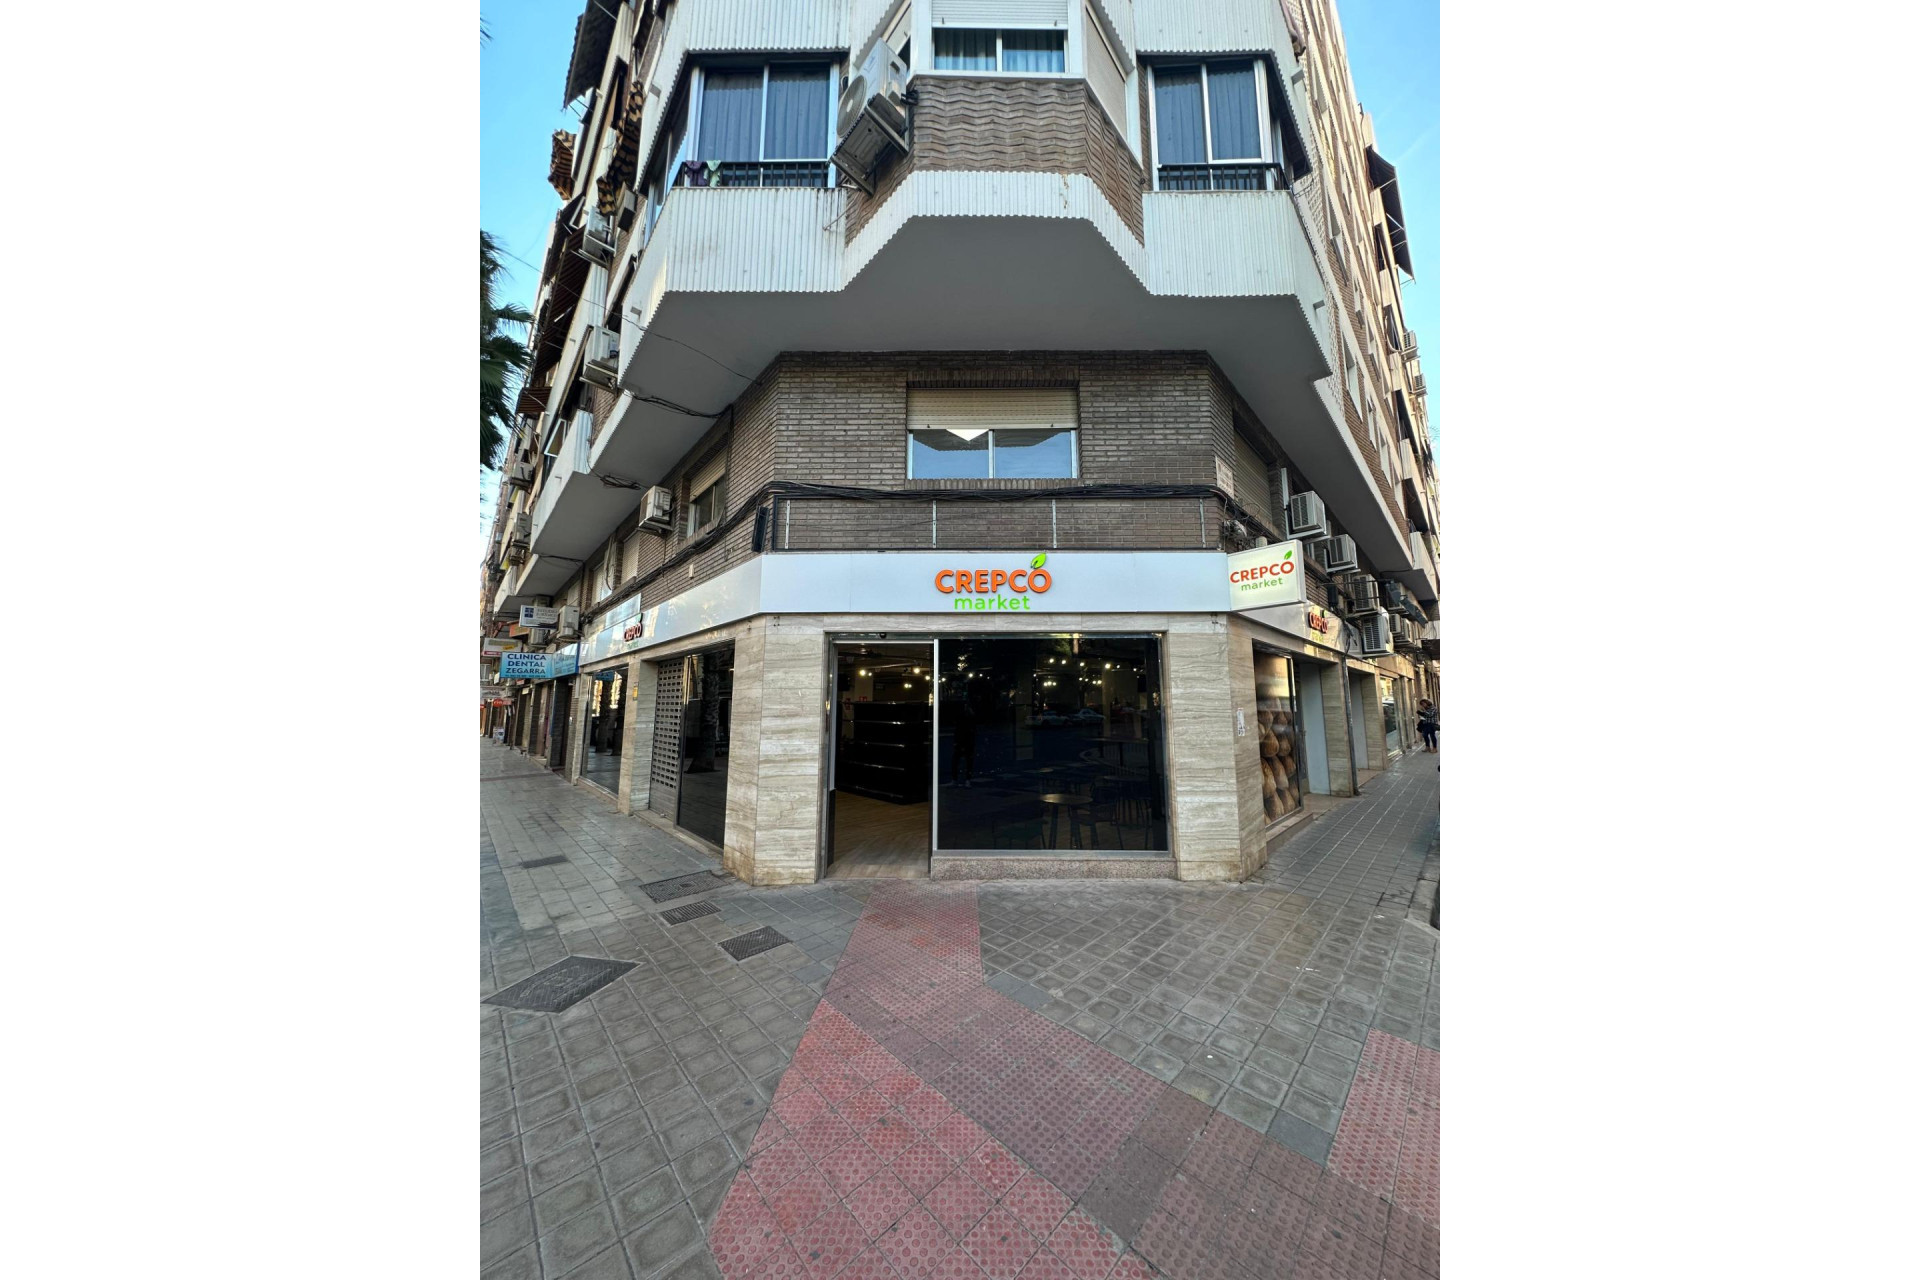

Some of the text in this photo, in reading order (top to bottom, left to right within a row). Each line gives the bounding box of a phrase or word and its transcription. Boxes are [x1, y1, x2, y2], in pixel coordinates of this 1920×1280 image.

[1230, 560, 1295, 584] CREPCO
[935, 568, 1053, 593] CREPCO
[1241, 577, 1283, 592] market
[954, 594, 1030, 610] market
[505, 667, 546, 675] ZEGARRA
